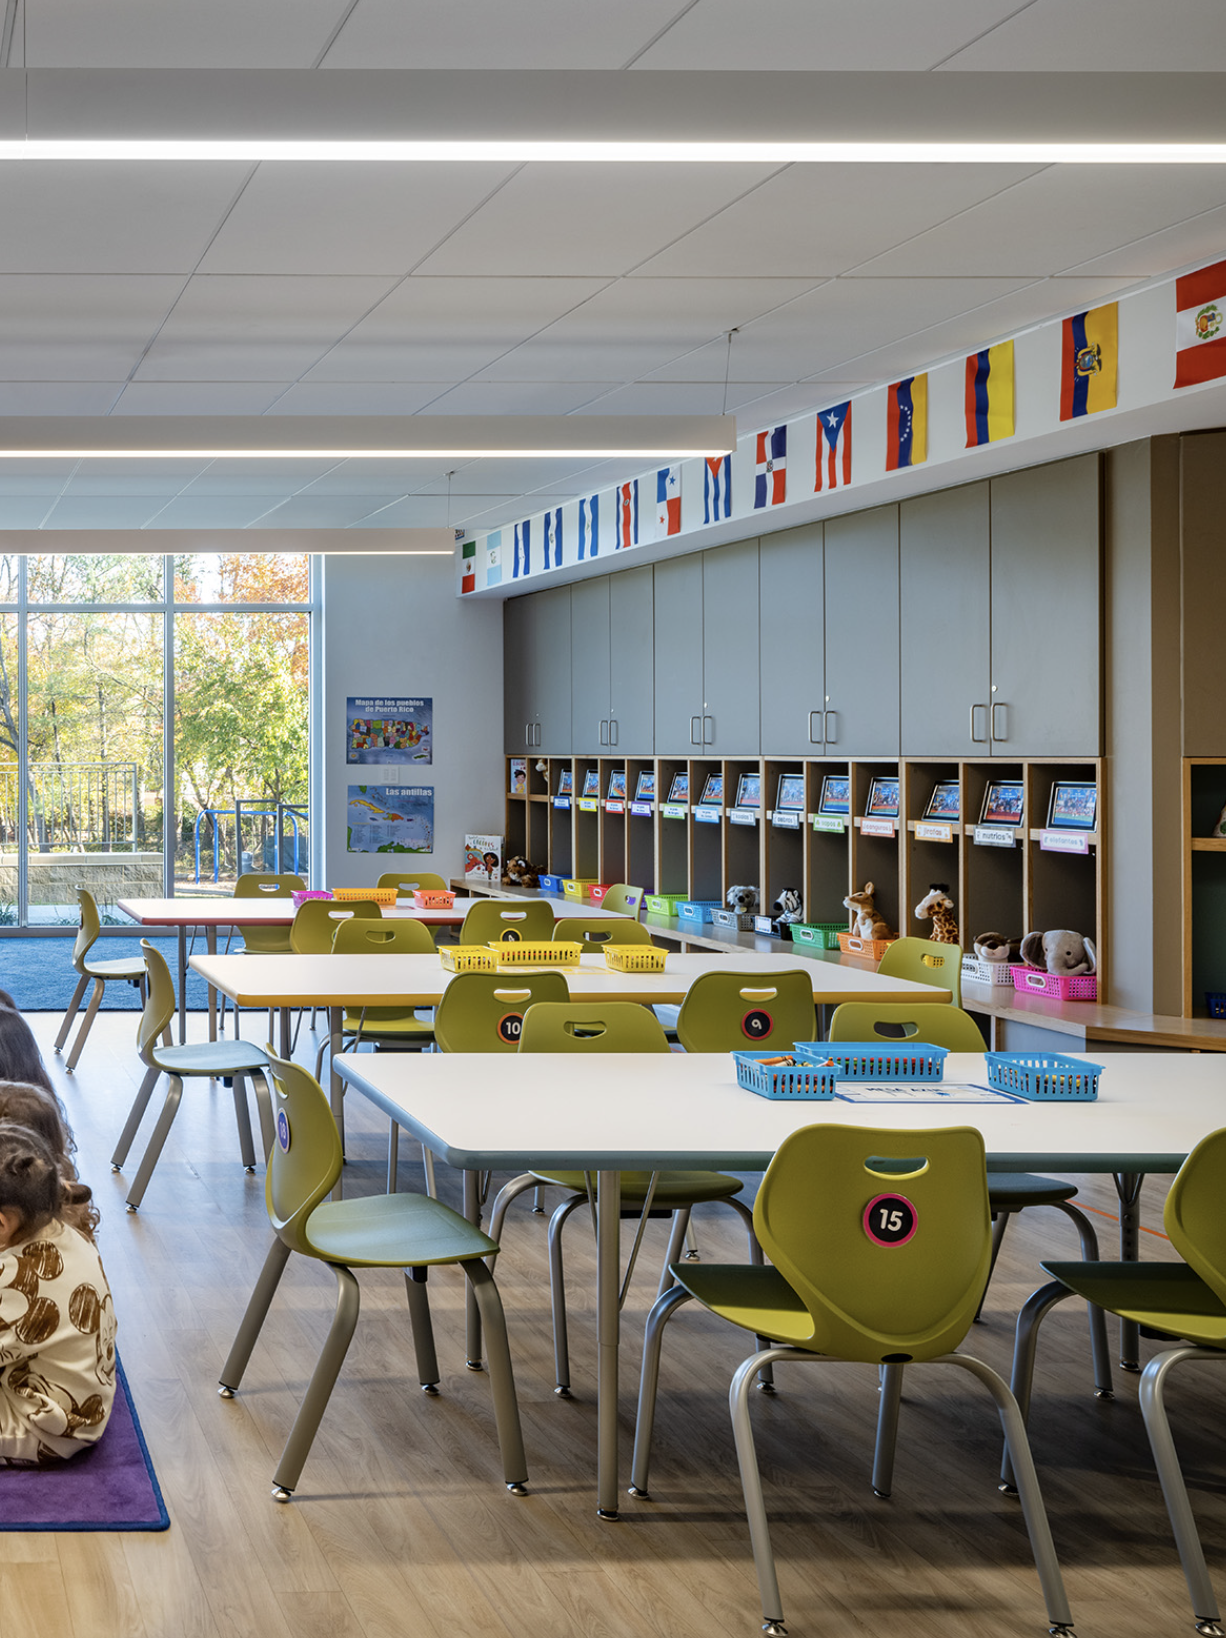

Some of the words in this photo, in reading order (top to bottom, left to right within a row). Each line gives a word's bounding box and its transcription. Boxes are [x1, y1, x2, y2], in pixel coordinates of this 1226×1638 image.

[355, 699, 373, 707] Mapa
[386, 787, 399, 796] Las
[401, 787, 432, 796] antillas
[506, 1022, 521, 1035] 10
[751, 1018, 762, 1030] 9
[879, 1208, 904, 1232] 15
